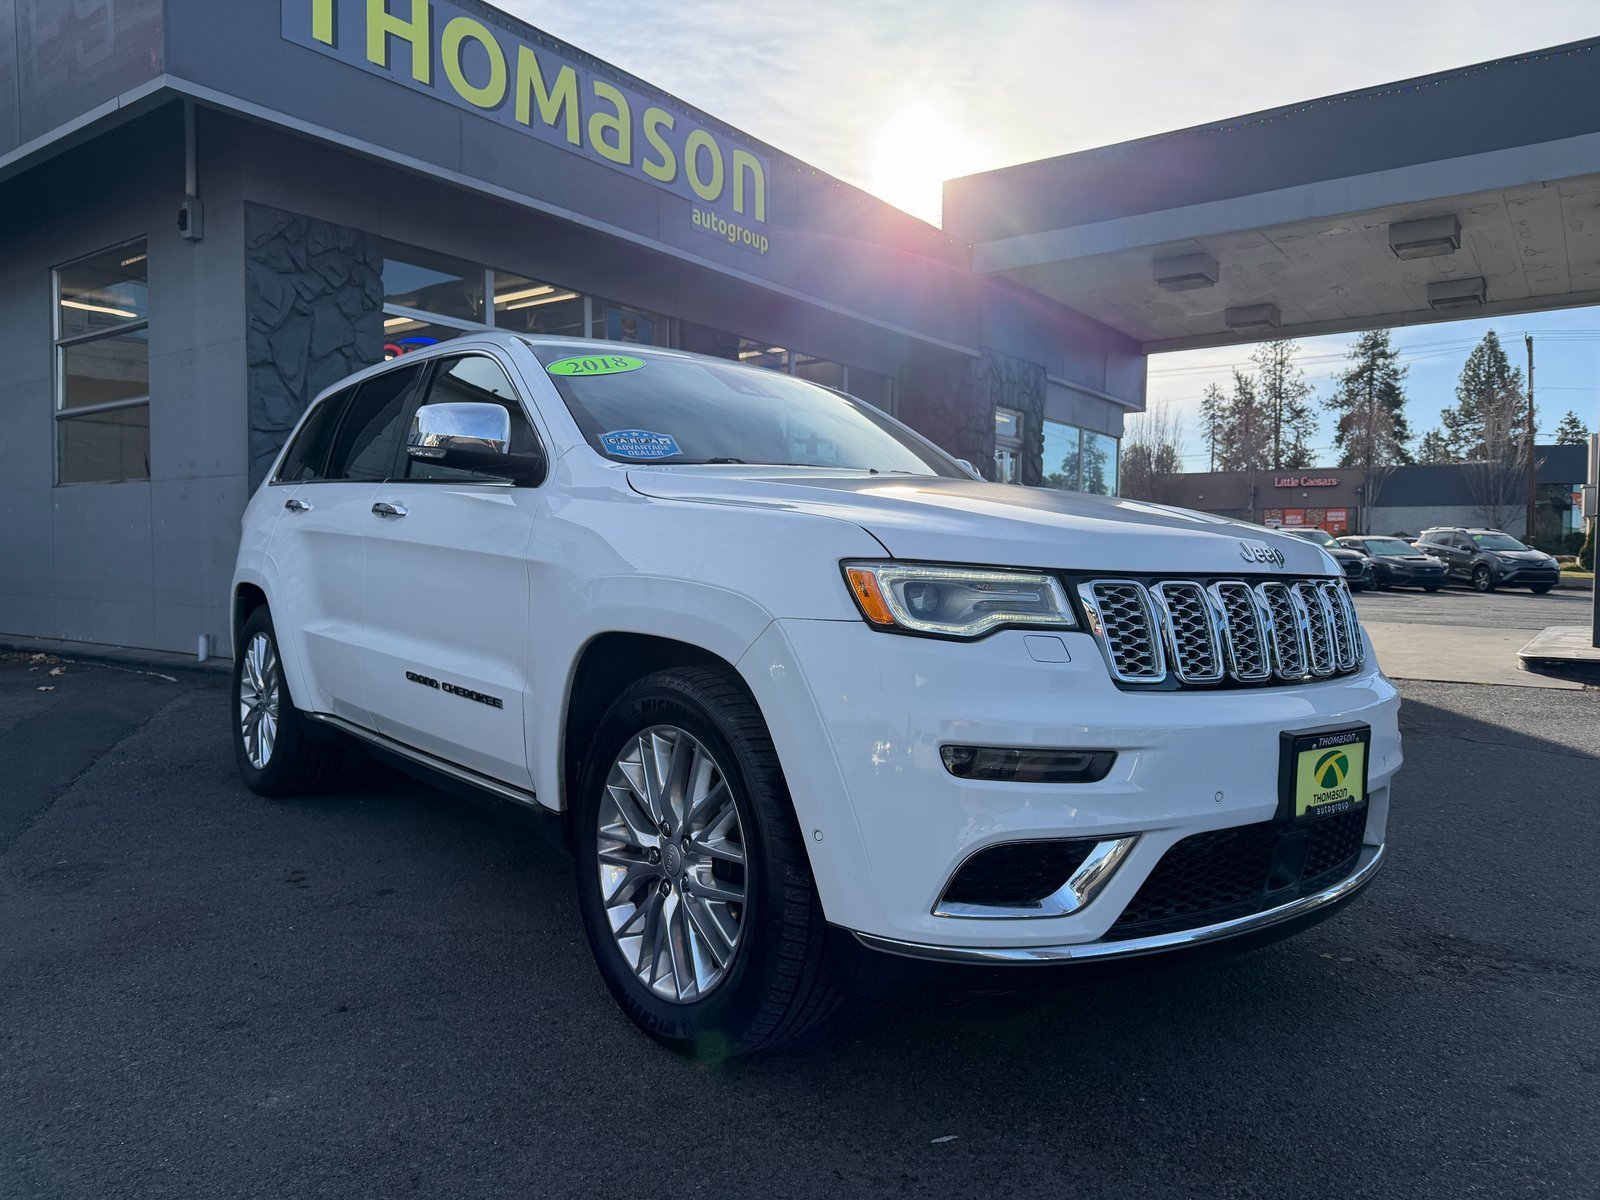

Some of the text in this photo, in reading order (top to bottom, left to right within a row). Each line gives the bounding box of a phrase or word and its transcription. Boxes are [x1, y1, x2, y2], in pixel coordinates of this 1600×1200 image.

[692, 208, 769, 255] autogroup
[566, 356, 628, 374] 2018
[1274, 476, 1338, 488] Little Caesars
[1239, 541, 1286, 569] Jeep
[442, 682, 504, 710] CHEROKEE
[1316, 801, 1349, 815] autogroup
